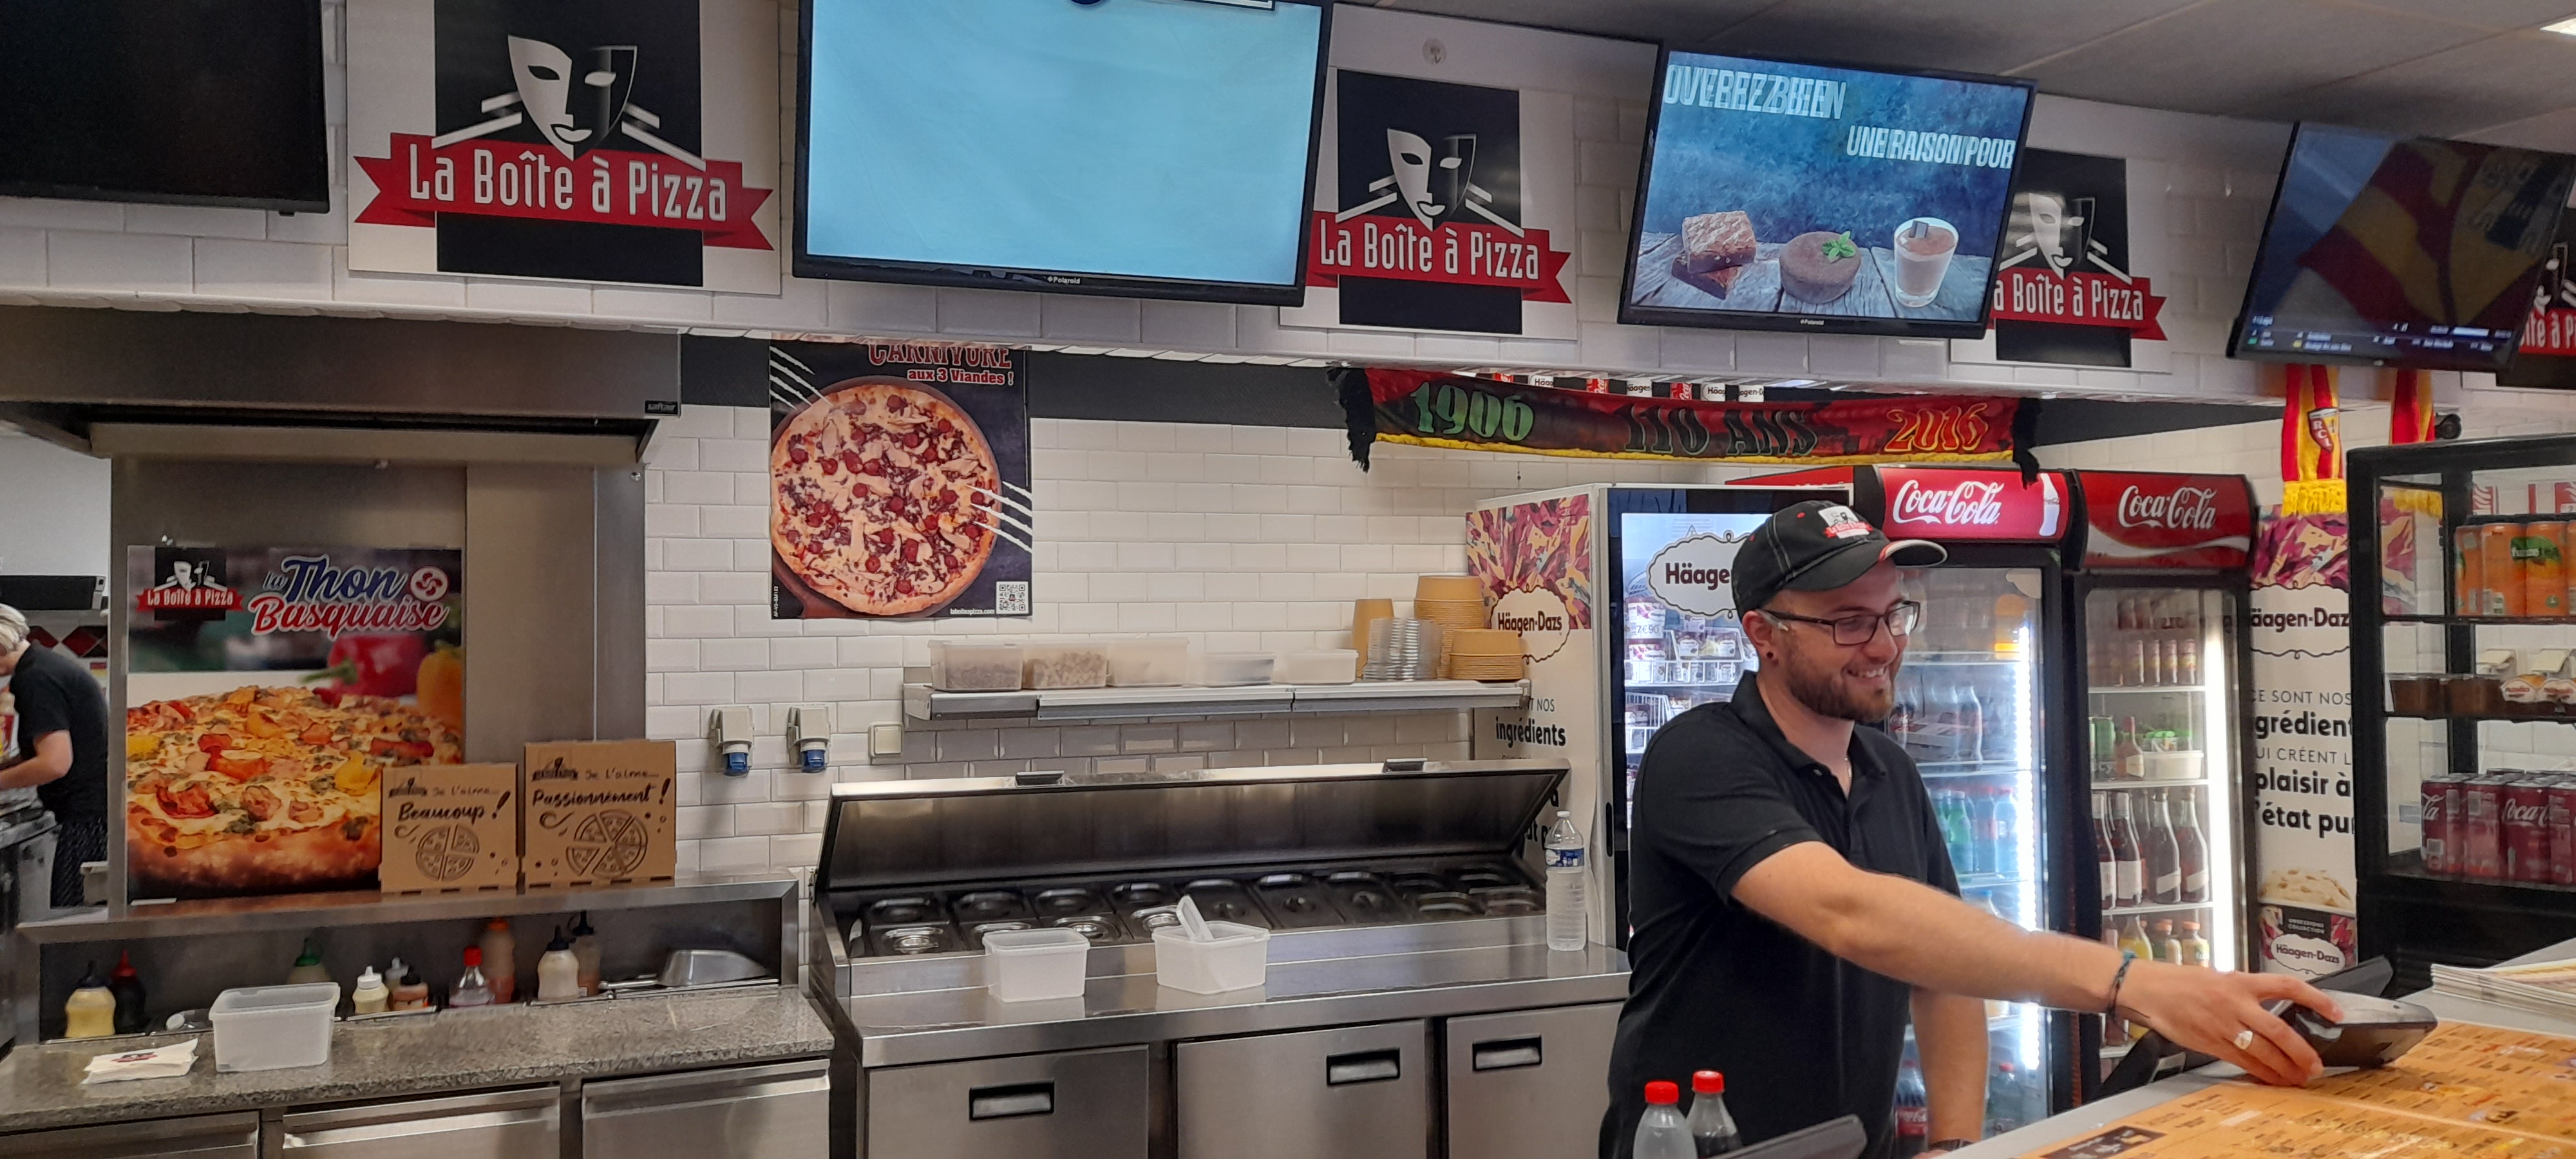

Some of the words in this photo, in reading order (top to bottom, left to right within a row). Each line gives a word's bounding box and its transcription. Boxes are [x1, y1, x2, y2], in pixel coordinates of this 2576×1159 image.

[410, 143, 455, 202] La
[474, 150, 573, 210] Boîte
[591, 155, 611, 214] à
[629, 160, 727, 222] Pizza
[1320, 218, 1351, 267] La
[1363, 222, 1433, 273] Boîte
[1444, 226, 1458, 274] à
[1470, 231, 1539, 280] Pizza
[2012, 273, 2065, 315] Boîte
[2072, 276, 2084, 317] à
[2091, 279, 2144, 321] Pizza
[2551, 310, 2561, 349] à
[907, 369, 936, 381] aux
[936, 368, 949, 382] 3
[950, 369, 1005, 385] Viandes
[1007, 371, 1014, 386] !
[1410, 381, 1535, 442] 1906
[1884, 402, 1989, 453] 2016
[1892, 478, 2005, 525] Coca-Cola
[2117, 484, 2219, 531] Coca-Cola
[281, 554, 408, 605] Thon
[1665, 562, 1731, 590] Häage
[147, 589, 161, 606] La
[204, 590, 234, 607] Pizza
[248, 594, 453, 641] Basquaise
[1497, 610, 1562, 638] Häagen-Dazs
[2250, 607, 2350, 633] äagen-Daz
[1537, 697, 1555, 712] NOS
[2271, 690, 2313, 704] SONT
[1495, 715, 1566, 748] ingrédients
[2277, 746, 2338, 764] CRÉENT
[2255, 766, 2329, 796] plaisir
[2336, 771, 2351, 791] à
[397, 802, 486, 825] Beaucoup
[2276, 943, 2341, 965] Häagen-Dazs
